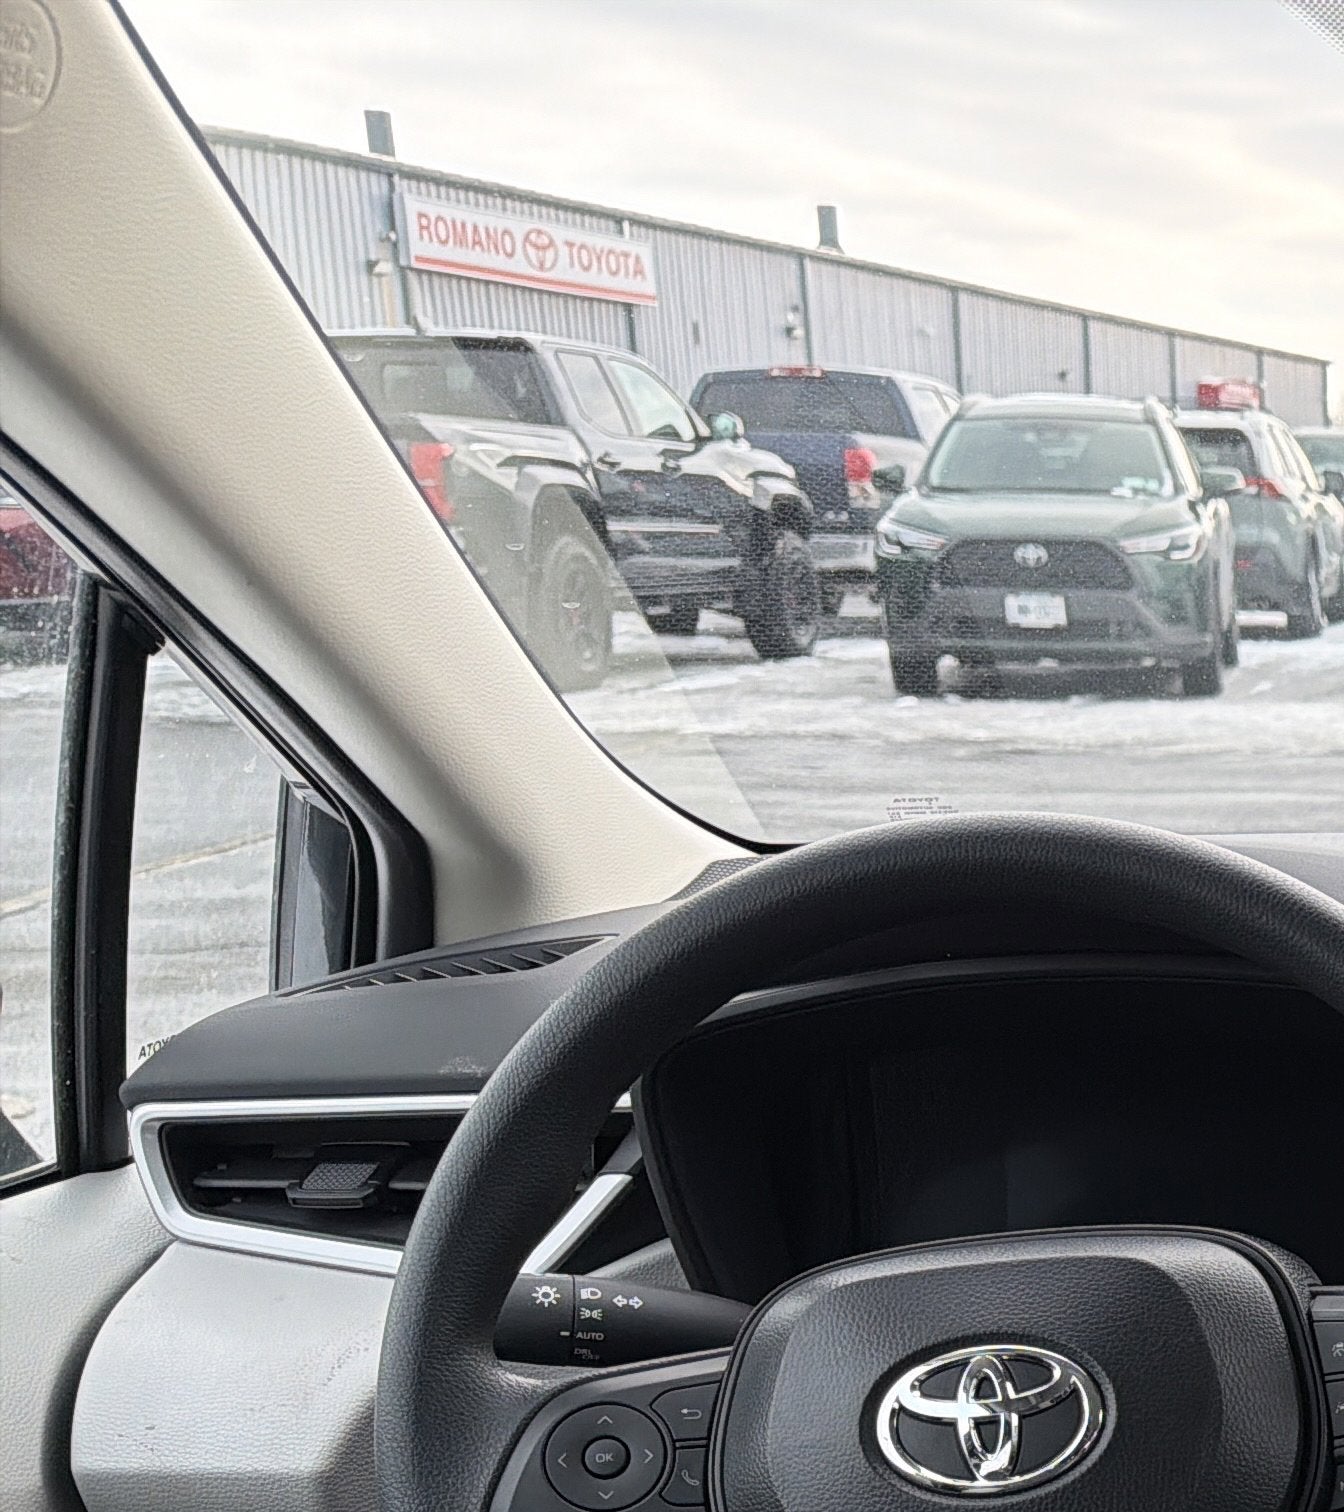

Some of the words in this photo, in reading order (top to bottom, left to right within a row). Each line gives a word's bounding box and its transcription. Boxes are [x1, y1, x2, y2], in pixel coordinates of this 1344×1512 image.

[416, 211, 517, 259] ROMANO
[564, 239, 648, 282] TOYOTA
[575, 1331, 605, 1341] AUTO
[595, 1452, 614, 1463] OK
